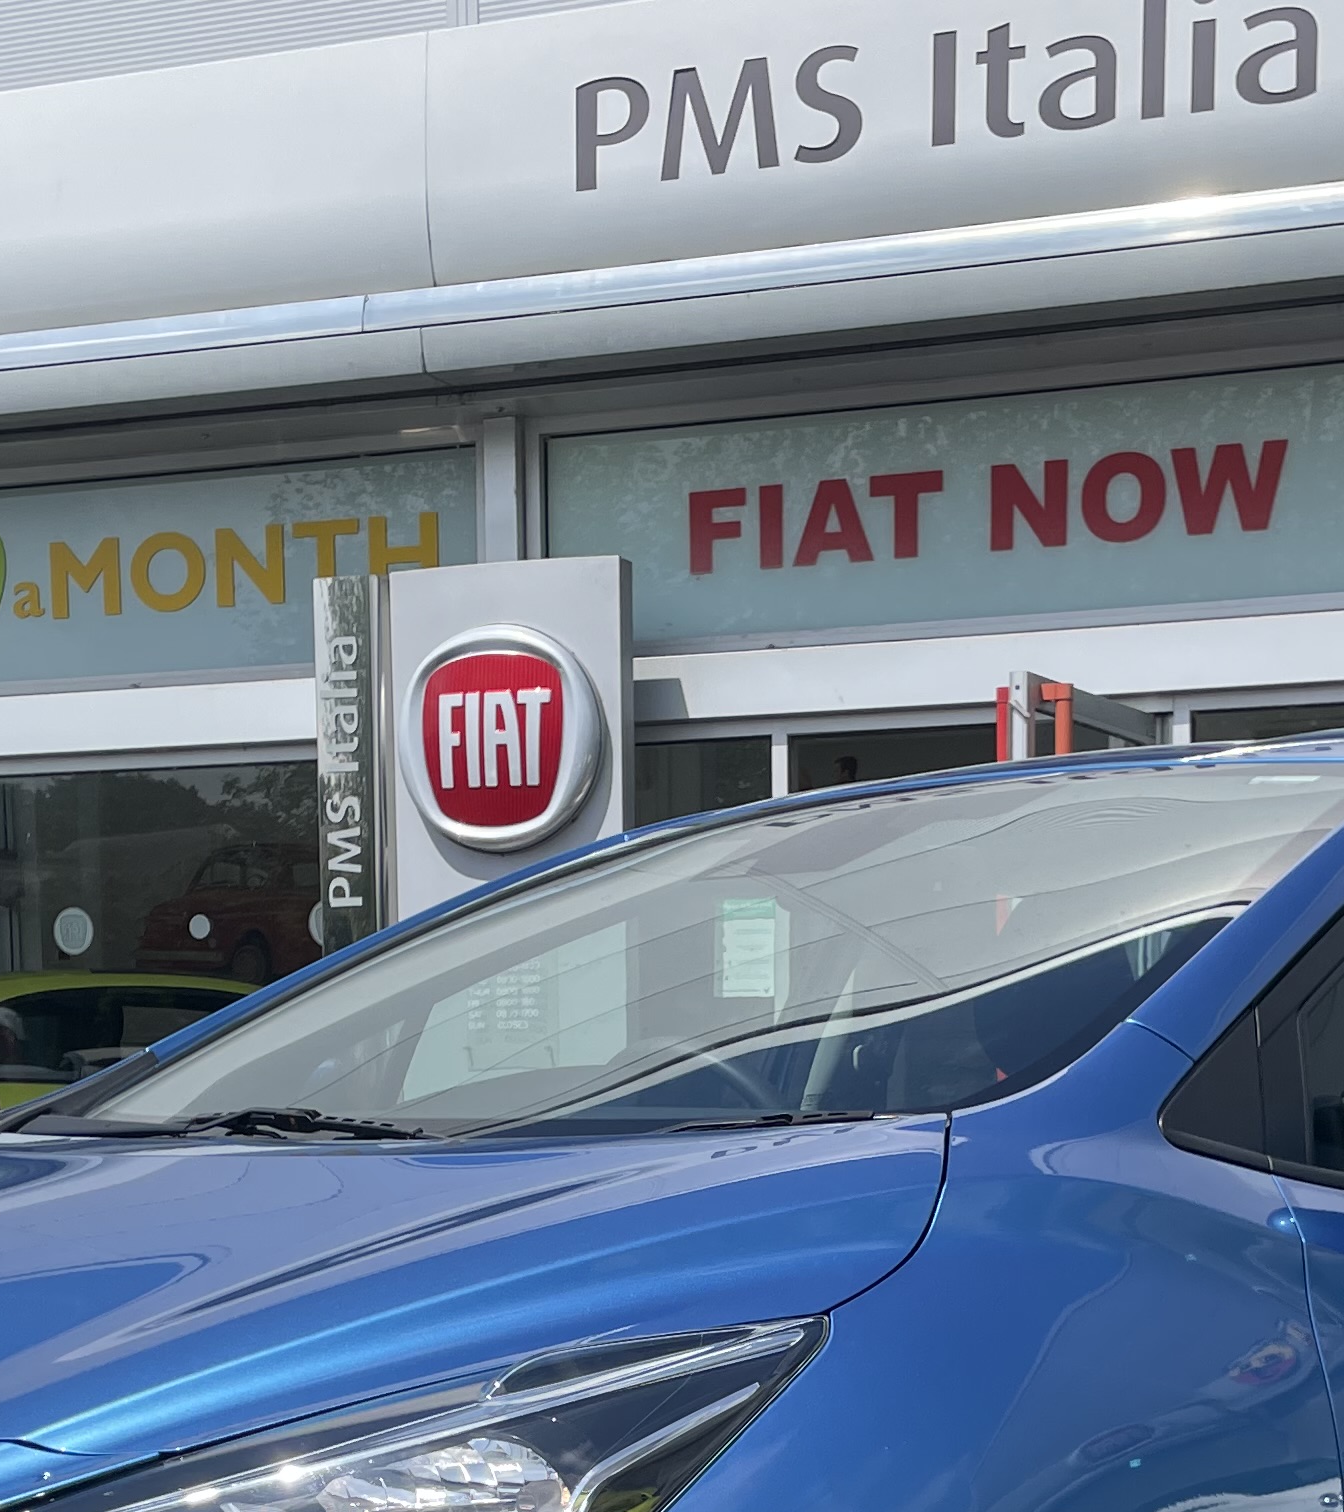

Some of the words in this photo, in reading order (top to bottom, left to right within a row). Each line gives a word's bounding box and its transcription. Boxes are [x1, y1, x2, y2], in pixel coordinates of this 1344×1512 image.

[575, 45, 864, 192] PMS
[930, 0, 1320, 147] Italia
[48, 511, 440, 620] MONTH
[688, 470, 944, 575] FIAT
[989, 439, 1289, 551] NOW
[319, 635, 360, 774] Italia
[437, 686, 551, 790] FIAT
[325, 795, 364, 908] PMS
